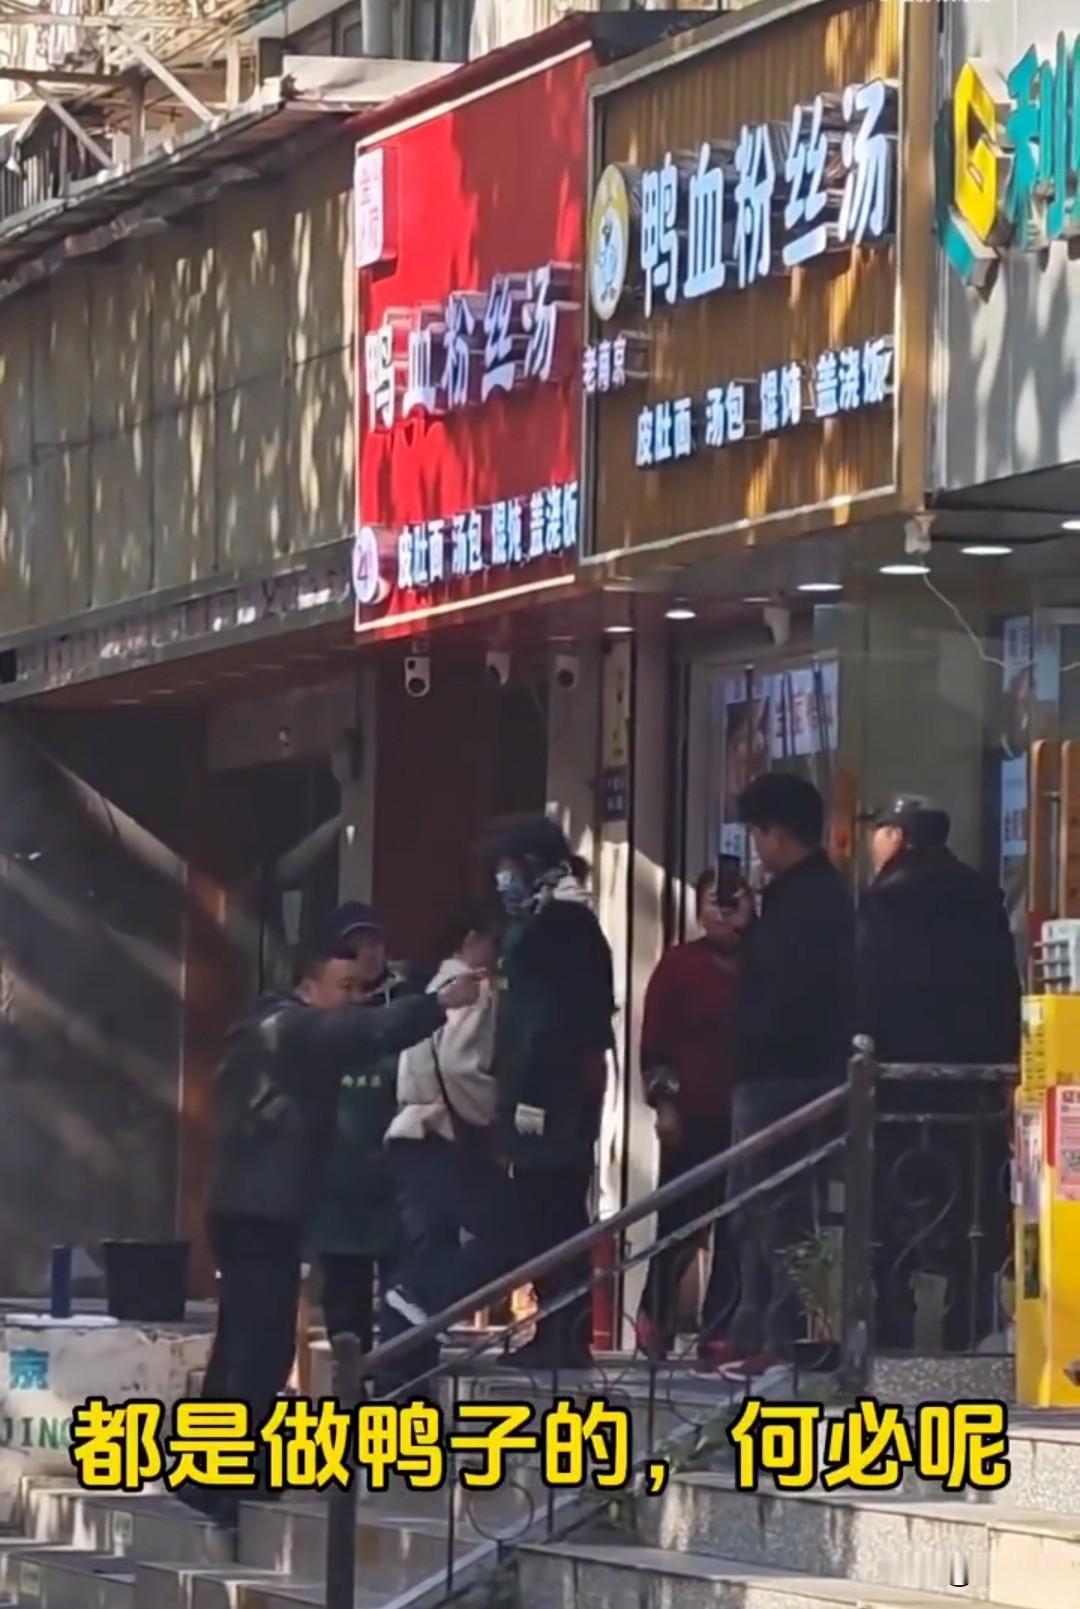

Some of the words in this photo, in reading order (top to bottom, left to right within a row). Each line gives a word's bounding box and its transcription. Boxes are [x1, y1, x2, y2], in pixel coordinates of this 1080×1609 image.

[640, 82, 889, 318] 鸭血粉丝汤
[1007, 31, 1080, 250] 利
[364, 265, 558, 432] 鸭血粉丝汤
[636, 398, 692, 466] 皮肚面
[705, 382, 746, 446] 汤包
[452, 509, 482, 574] 汤包
